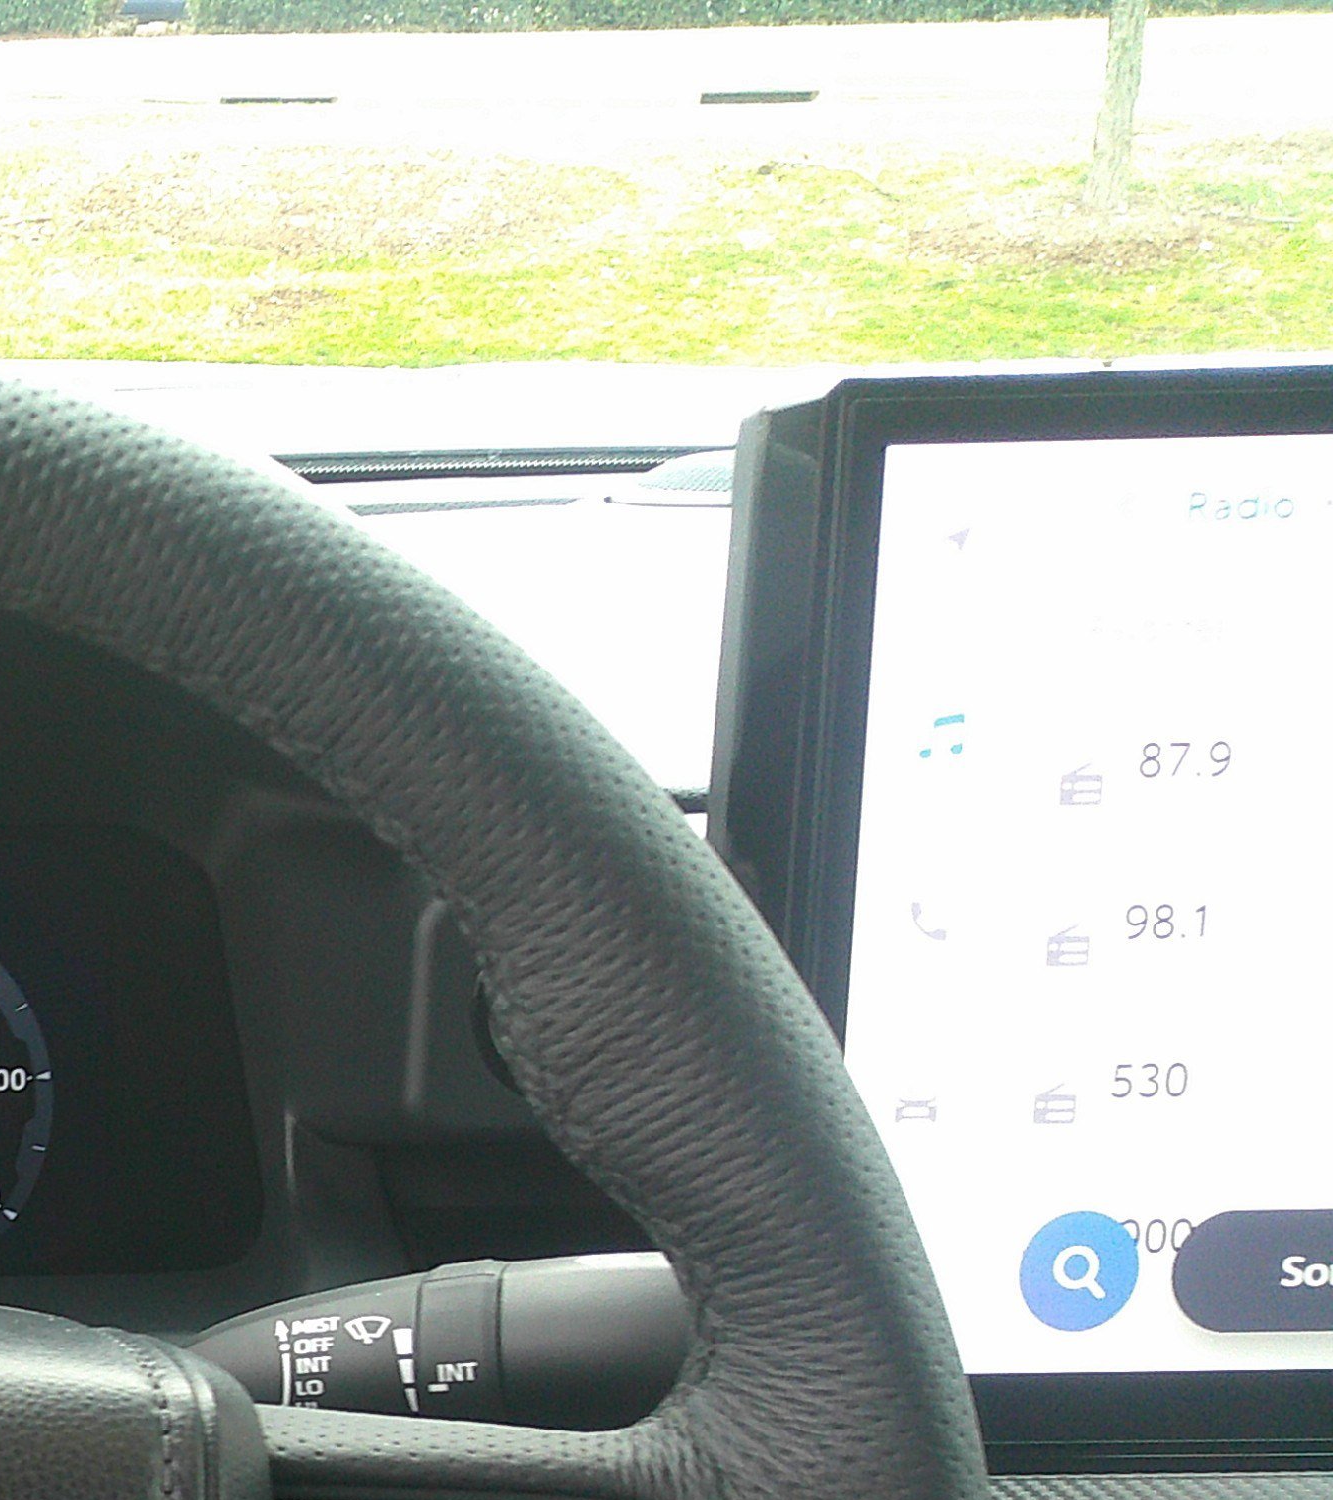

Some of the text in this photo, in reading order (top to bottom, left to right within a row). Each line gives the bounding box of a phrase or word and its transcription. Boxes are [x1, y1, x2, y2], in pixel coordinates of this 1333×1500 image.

[1187, 491, 1295, 521] Radio
[1140, 741, 1232, 778] 87.9
[1125, 904, 1208, 940] 98.1
[1110, 1061, 1189, 1098] 530
[291, 1316, 340, 1336] MIST
[293, 1336, 334, 1354] OFF
[294, 1356, 332, 1374] INT
[436, 1361, 478, 1383] INT
[294, 1379, 325, 1398] LO
